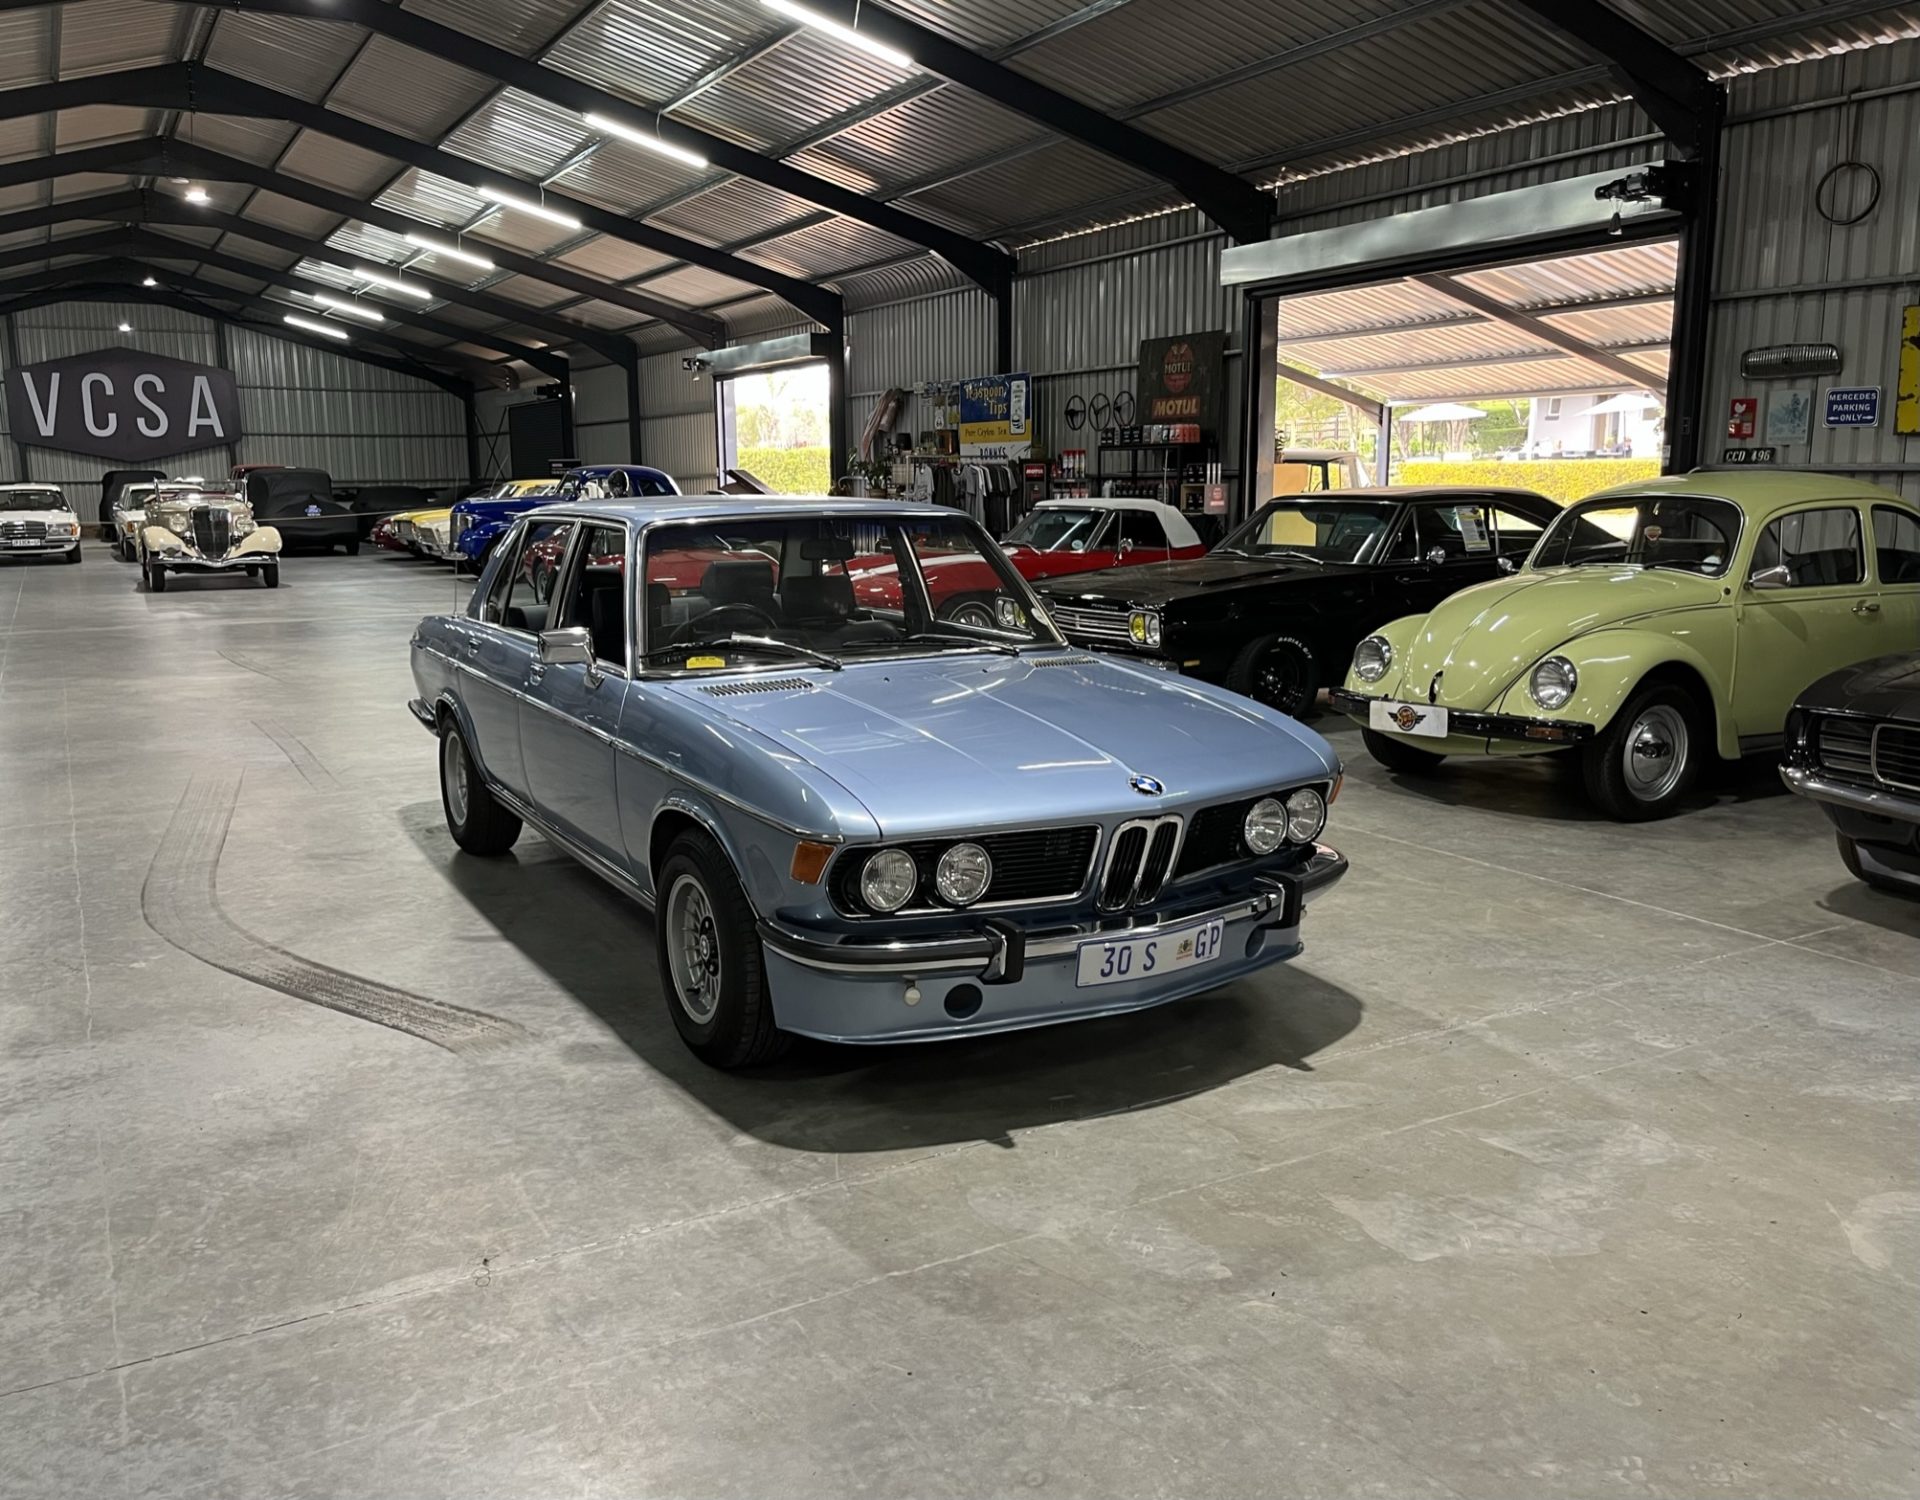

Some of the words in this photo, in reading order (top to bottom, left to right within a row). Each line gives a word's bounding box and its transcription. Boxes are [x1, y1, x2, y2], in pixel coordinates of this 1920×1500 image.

[1164, 361, 1191, 373] MOTUL
[964, 383, 1004, 401] Teaspoon
[1829, 392, 1877, 401] MERCEDES
[21, 371, 225, 438] VCSA
[988, 400, 1008, 419] Tips
[1153, 398, 1198, 417] MOTUL
[1832, 403, 1871, 412] PARKING
[1839, 413, 1863, 422] ONLY
[1726, 449, 1745, 462] CCD
[1751, 449, 1771, 461] 496
[1100, 946, 1131, 978] 30
[1142, 942, 1157, 971] S
[1194, 926, 1220, 959] GP
